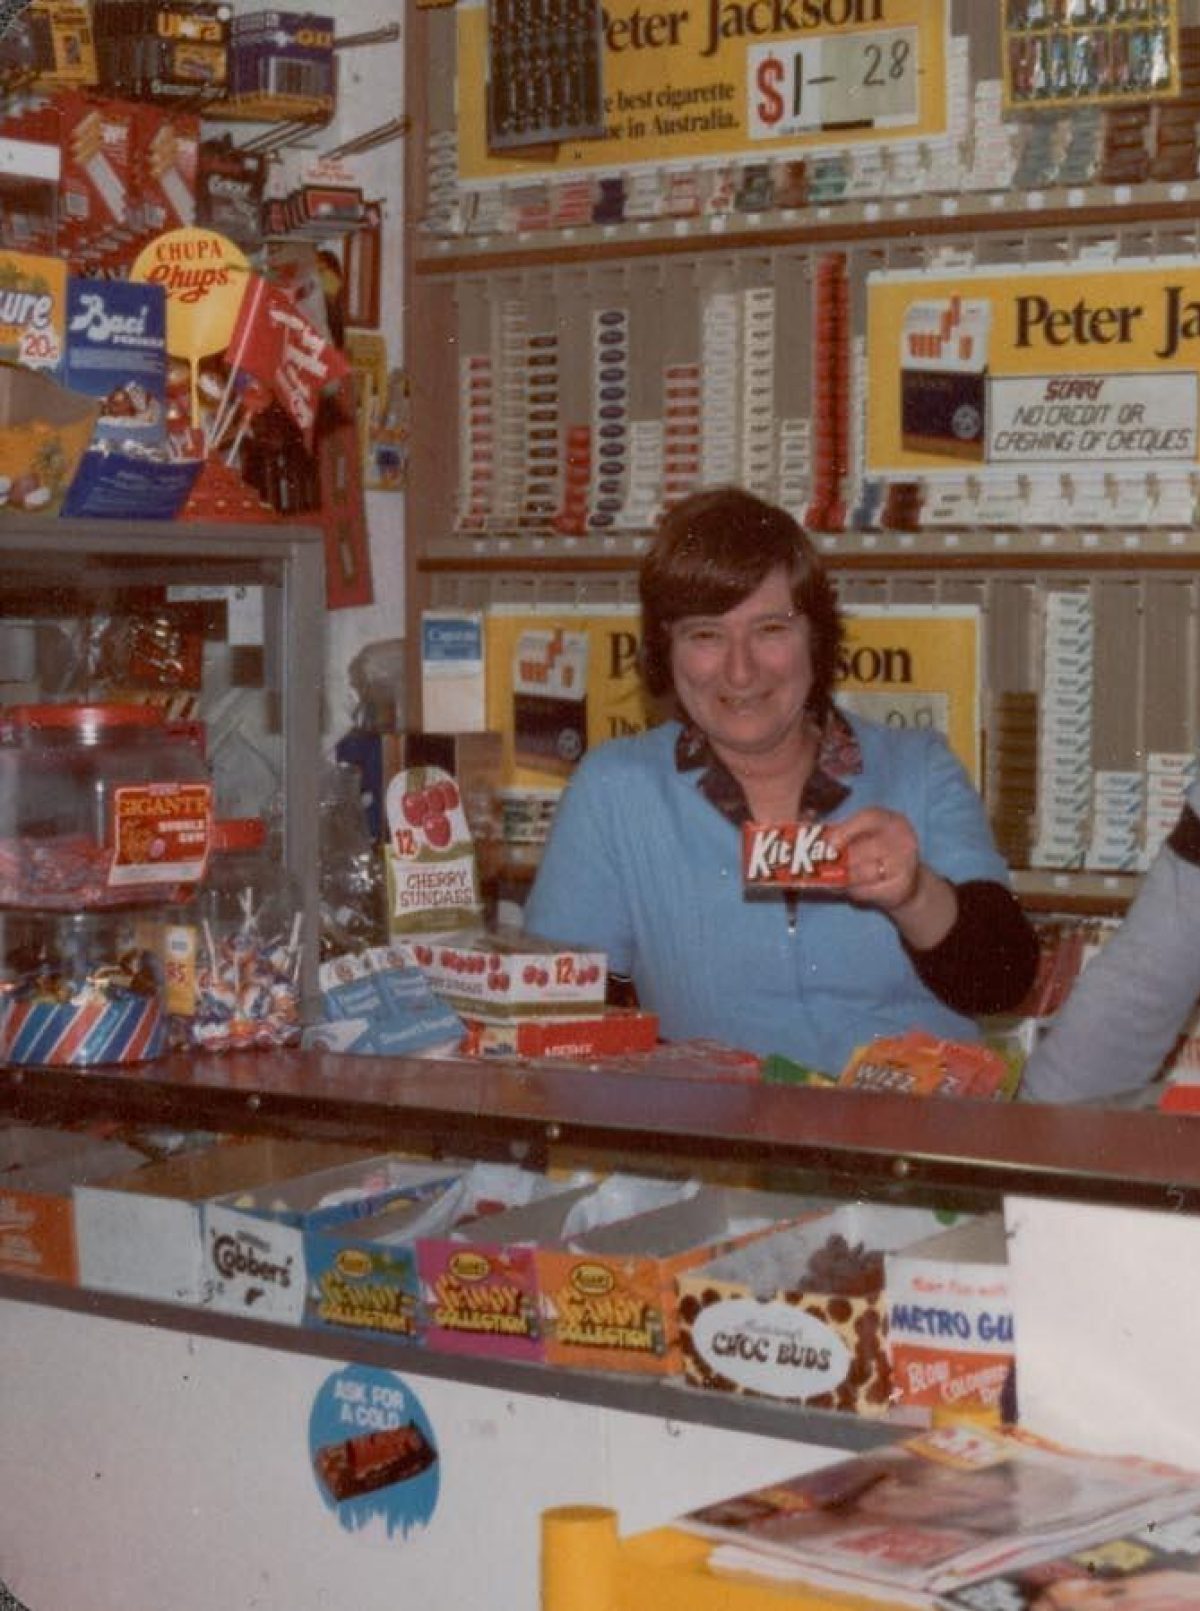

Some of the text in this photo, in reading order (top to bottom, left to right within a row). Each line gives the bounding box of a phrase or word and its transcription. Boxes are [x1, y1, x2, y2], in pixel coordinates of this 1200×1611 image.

[601, 0, 886, 57] eter Jackson
[617, 88, 652, 112] best
[655, 82, 736, 110] cigarette
[627, 117, 646, 138] in
[156, 239, 224, 262] CHUPA
[145, 264, 230, 304] Chups
[1013, 295, 1146, 348] Peter
[1043, 378, 1105, 402] SORRY
[1013, 401, 1147, 428] NO CREDIT OR
[994, 427, 1193, 455] CASHING OF CHEQUES
[406, 869, 468, 890] CHERRY
[555, 956, 575, 985] 12
[890, 1303, 972, 1340] METRO
[711, 1332, 833, 1372] CHOC BUDS
